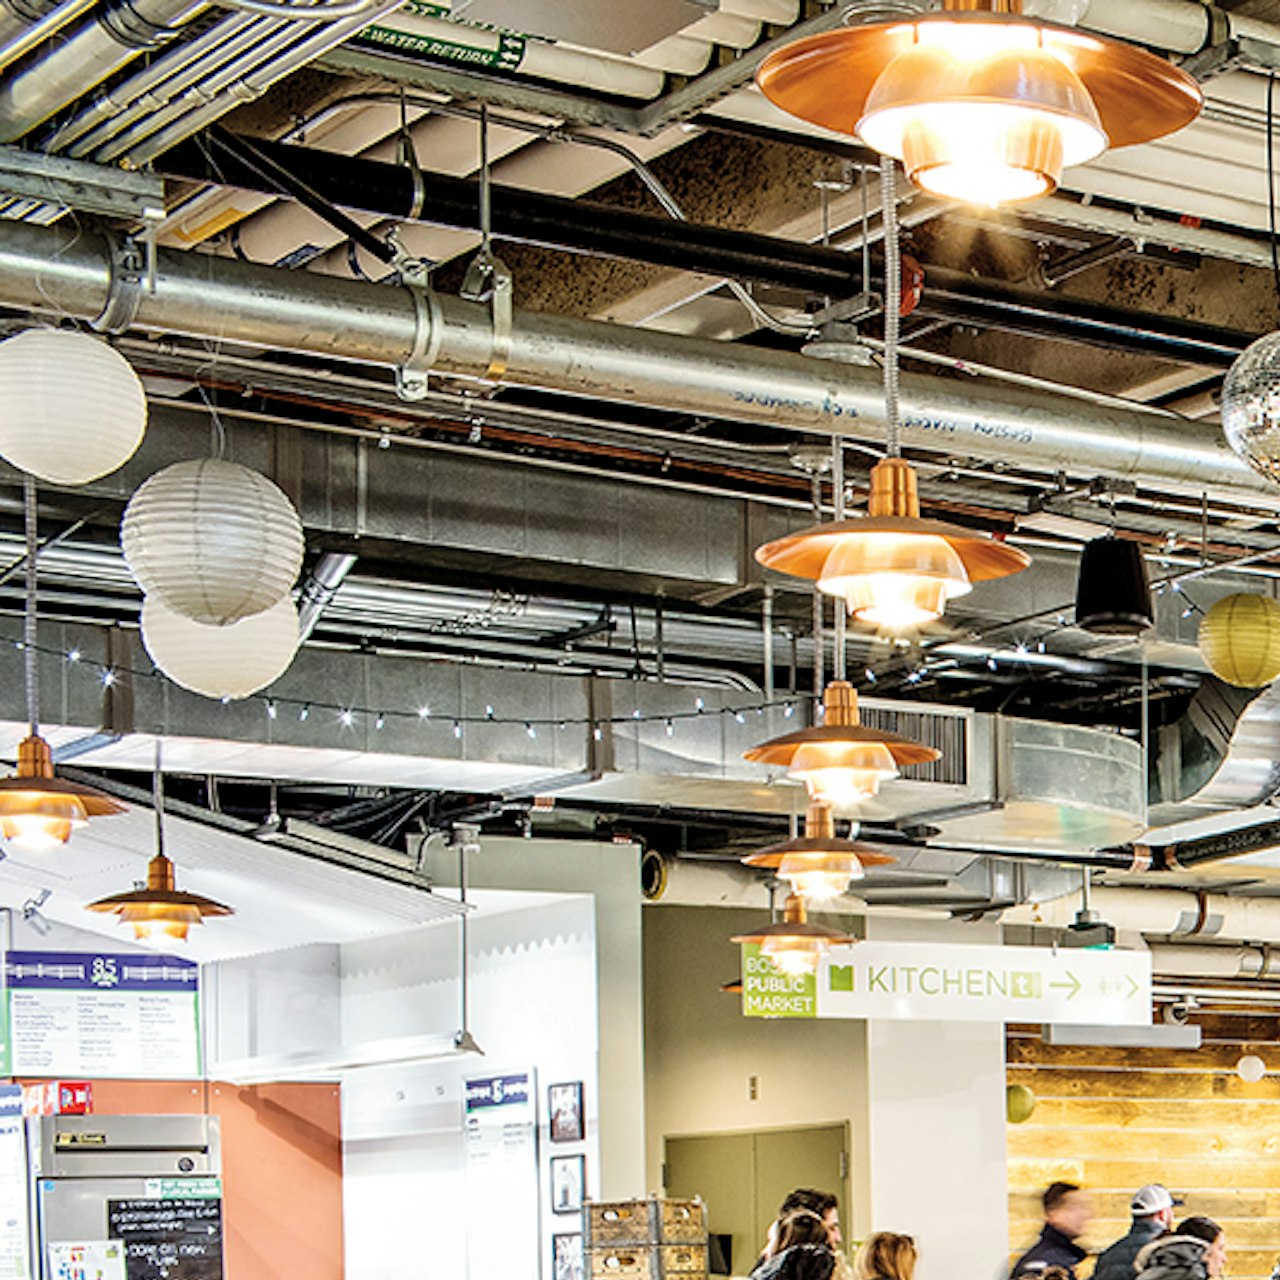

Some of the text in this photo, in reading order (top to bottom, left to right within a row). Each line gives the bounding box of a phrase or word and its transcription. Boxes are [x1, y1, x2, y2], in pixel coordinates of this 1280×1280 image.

[370, 29, 428, 55] WATER
[428, 42, 494, 68] RETURN
[92, 957, 117, 975] 85
[747, 978, 805, 993] PUBLIC
[868, 966, 1008, 997] KITCHEN
[747, 997, 813, 1012] MARKET
